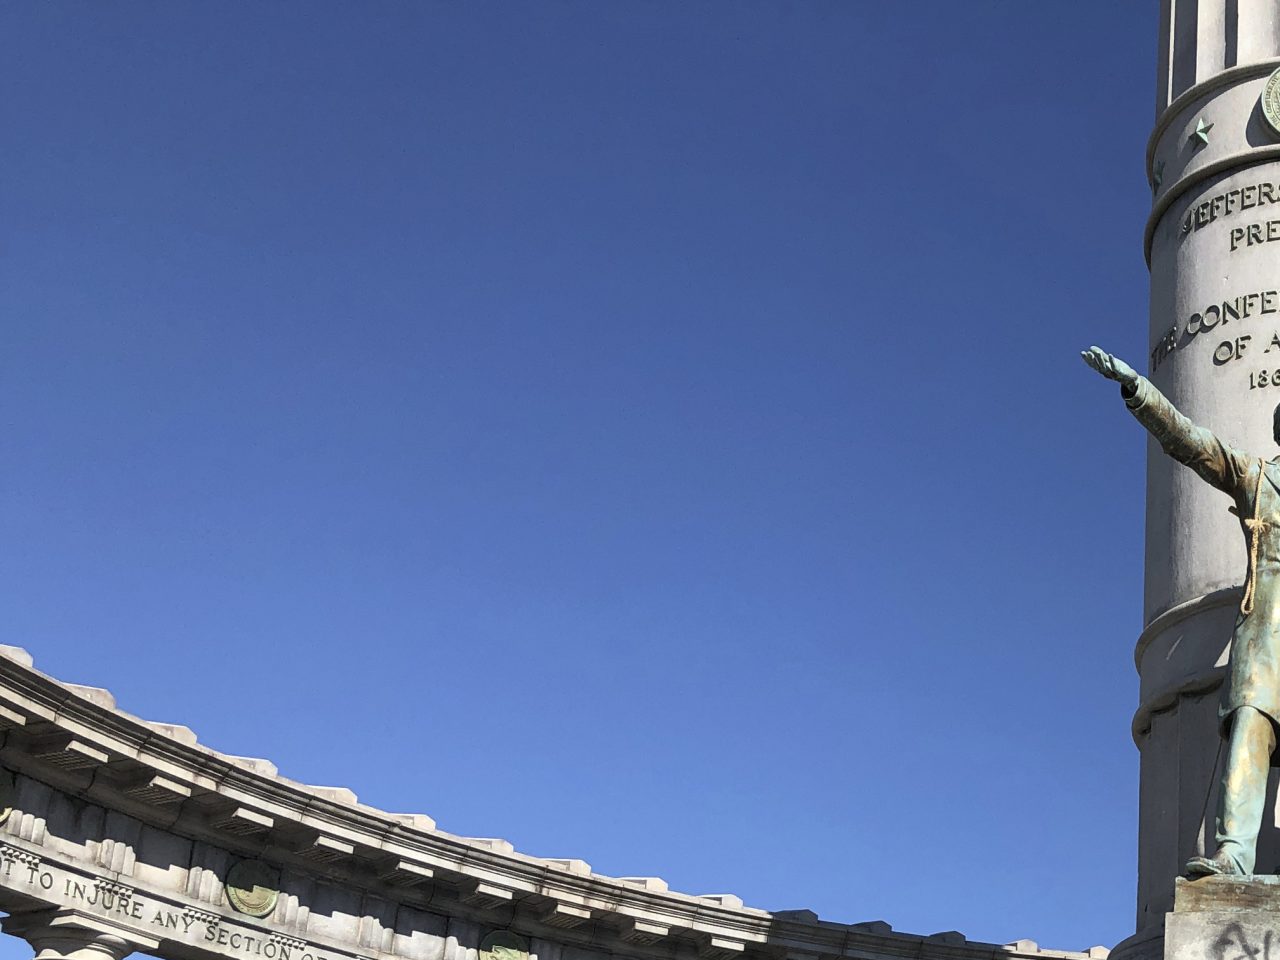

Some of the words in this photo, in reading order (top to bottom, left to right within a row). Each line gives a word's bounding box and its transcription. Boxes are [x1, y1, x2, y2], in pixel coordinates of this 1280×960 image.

[1213, 335, 1252, 366] OF
[27, 866, 53, 889] TO
[64, 878, 144, 920] INJURE
[151, 911, 195, 933] ANY
